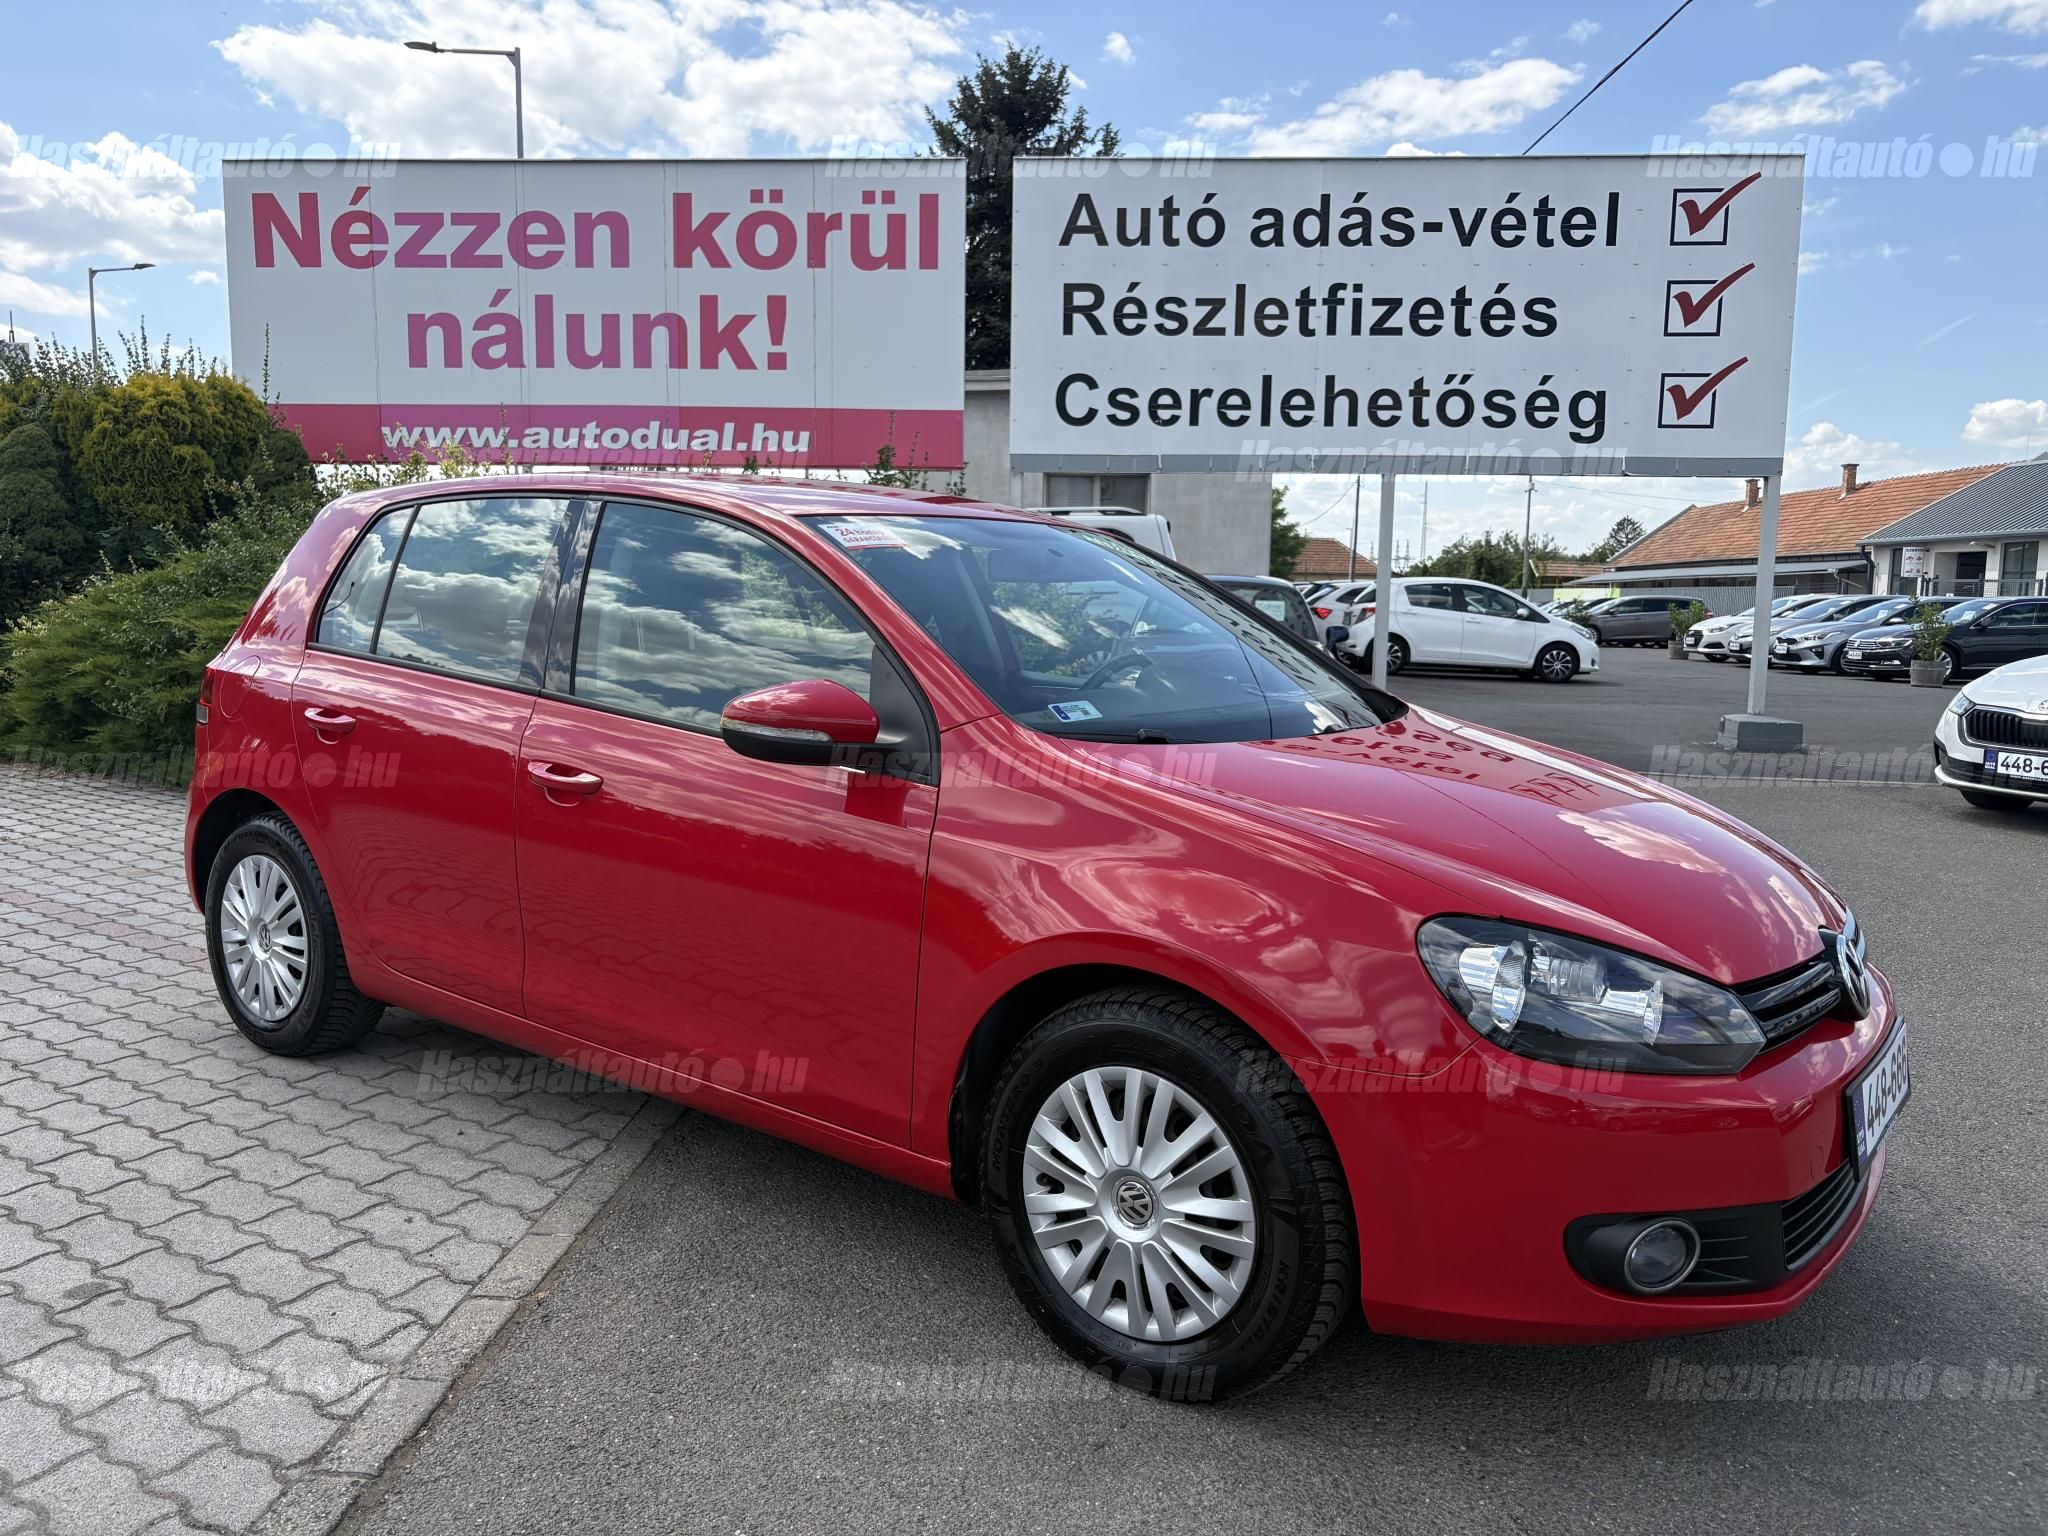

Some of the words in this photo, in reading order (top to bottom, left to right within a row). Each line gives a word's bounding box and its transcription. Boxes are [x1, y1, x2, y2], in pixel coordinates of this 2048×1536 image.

[252, 187, 630, 269] Nézzen
[672, 189, 940, 271] körül
[1058, 192, 1227, 248] Autó
[1249, 191, 1621, 249] adás-vétel
[407, 289, 788, 371] nálunk!
[1061, 281, 1559, 338] Részletfizetés
[381, 420, 812, 456] www.autodual.hu
[1054, 373, 1607, 444] Cserelehetőség
[1867, 1036, 1908, 1138] 448-666
